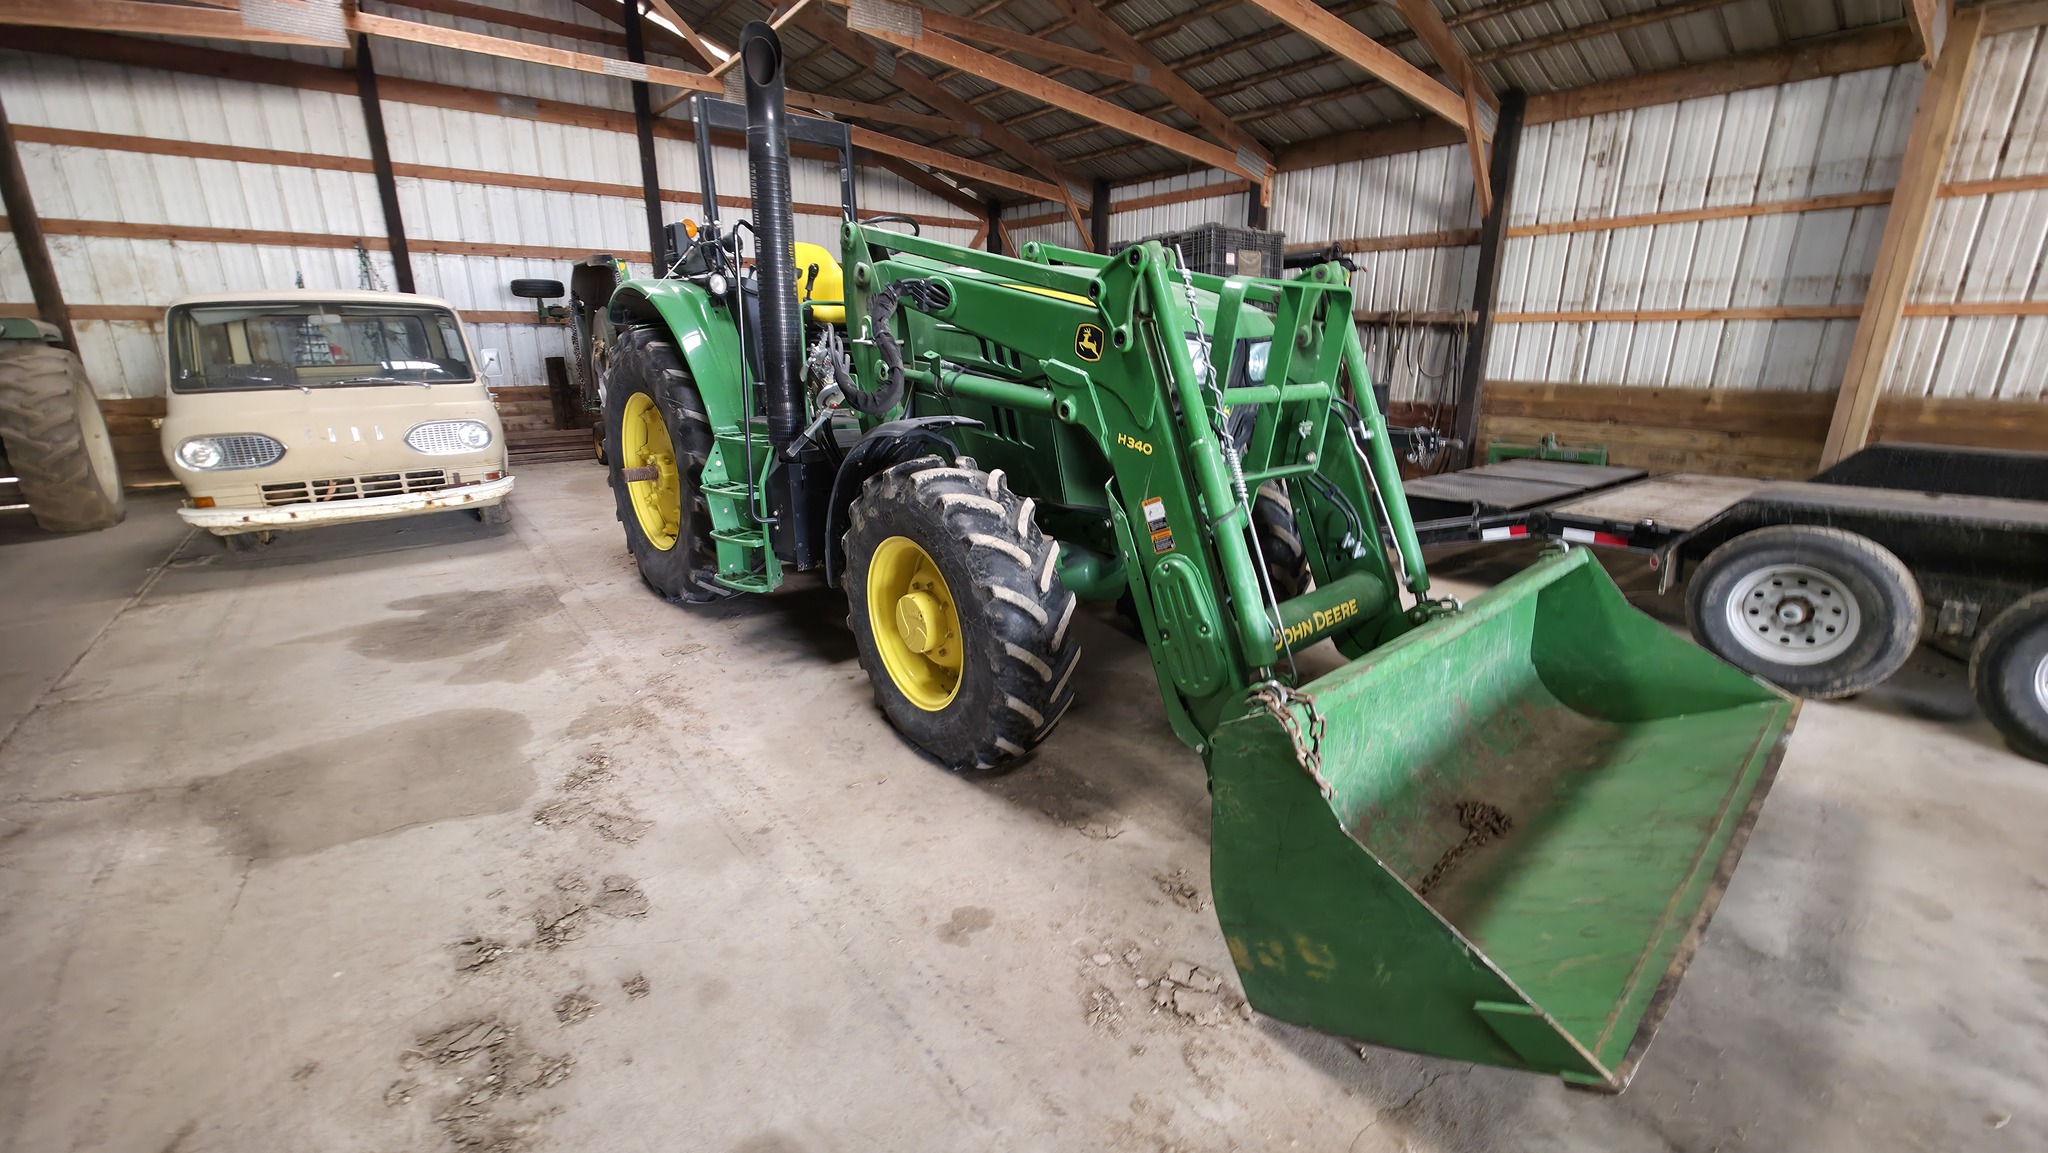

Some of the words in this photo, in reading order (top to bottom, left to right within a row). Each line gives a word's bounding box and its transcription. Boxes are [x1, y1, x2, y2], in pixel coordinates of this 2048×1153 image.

[1117, 432, 1153, 456] H340
[1274, 618, 1313, 652] JOHN
[1312, 598, 1359, 632] DEERE
